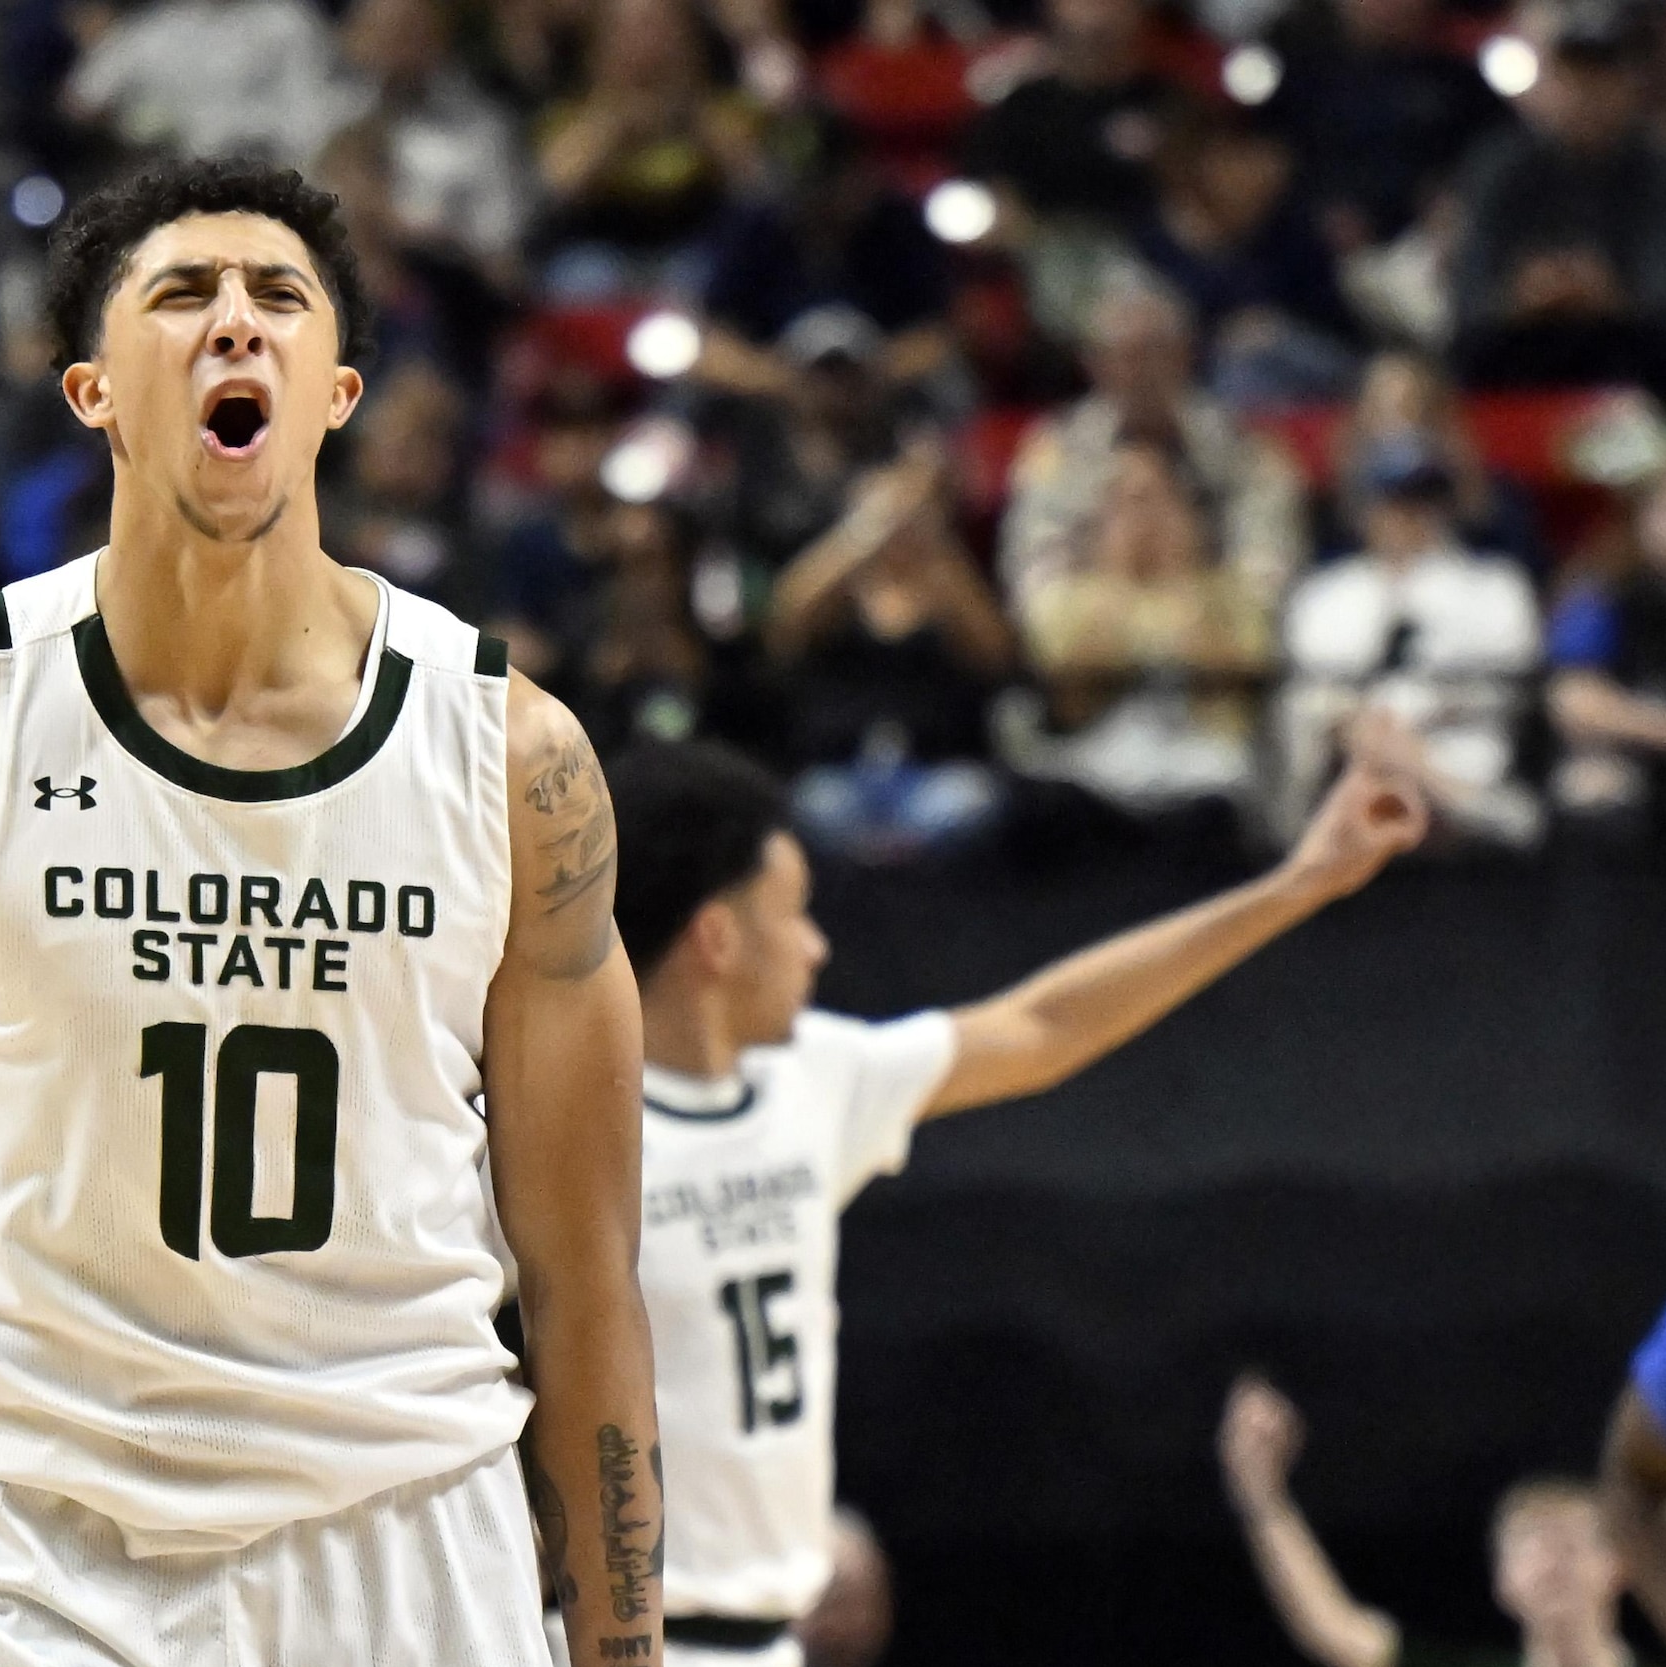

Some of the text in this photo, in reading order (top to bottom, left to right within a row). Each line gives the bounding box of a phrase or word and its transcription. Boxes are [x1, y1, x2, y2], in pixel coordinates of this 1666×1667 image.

[44, 865, 434, 939] COLORADO
[131, 929, 349, 992] STATE
[139, 1021, 339, 1262] 10
[719, 1269, 803, 1435] 15
